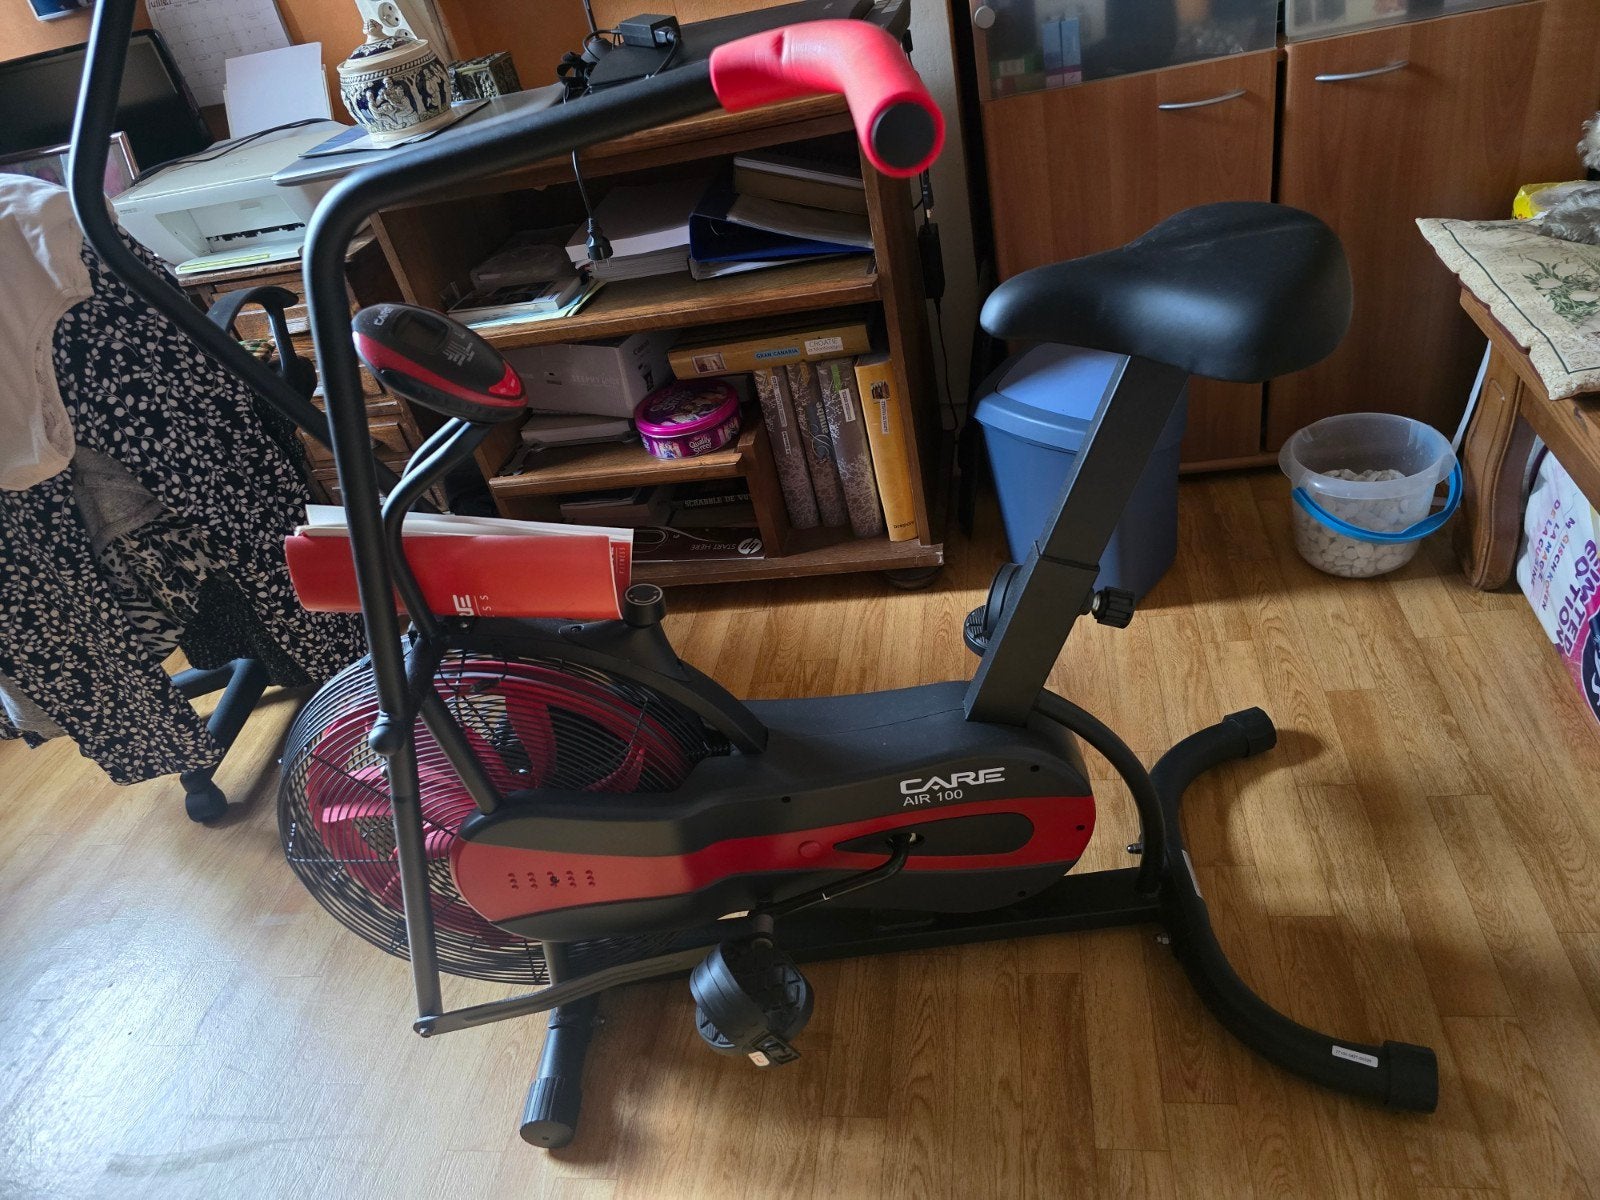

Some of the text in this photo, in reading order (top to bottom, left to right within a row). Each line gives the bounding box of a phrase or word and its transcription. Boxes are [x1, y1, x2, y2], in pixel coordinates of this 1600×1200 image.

[374, 306, 394, 325] CARE
[773, 347, 798, 356] CANARIA
[688, 437, 711, 448] Quality
[1551, 517, 1576, 572] MGISCH
[1556, 540, 1597, 645] EDTION
[900, 767, 1006, 795] CARE
[903, 789, 963, 807] AIR 100
